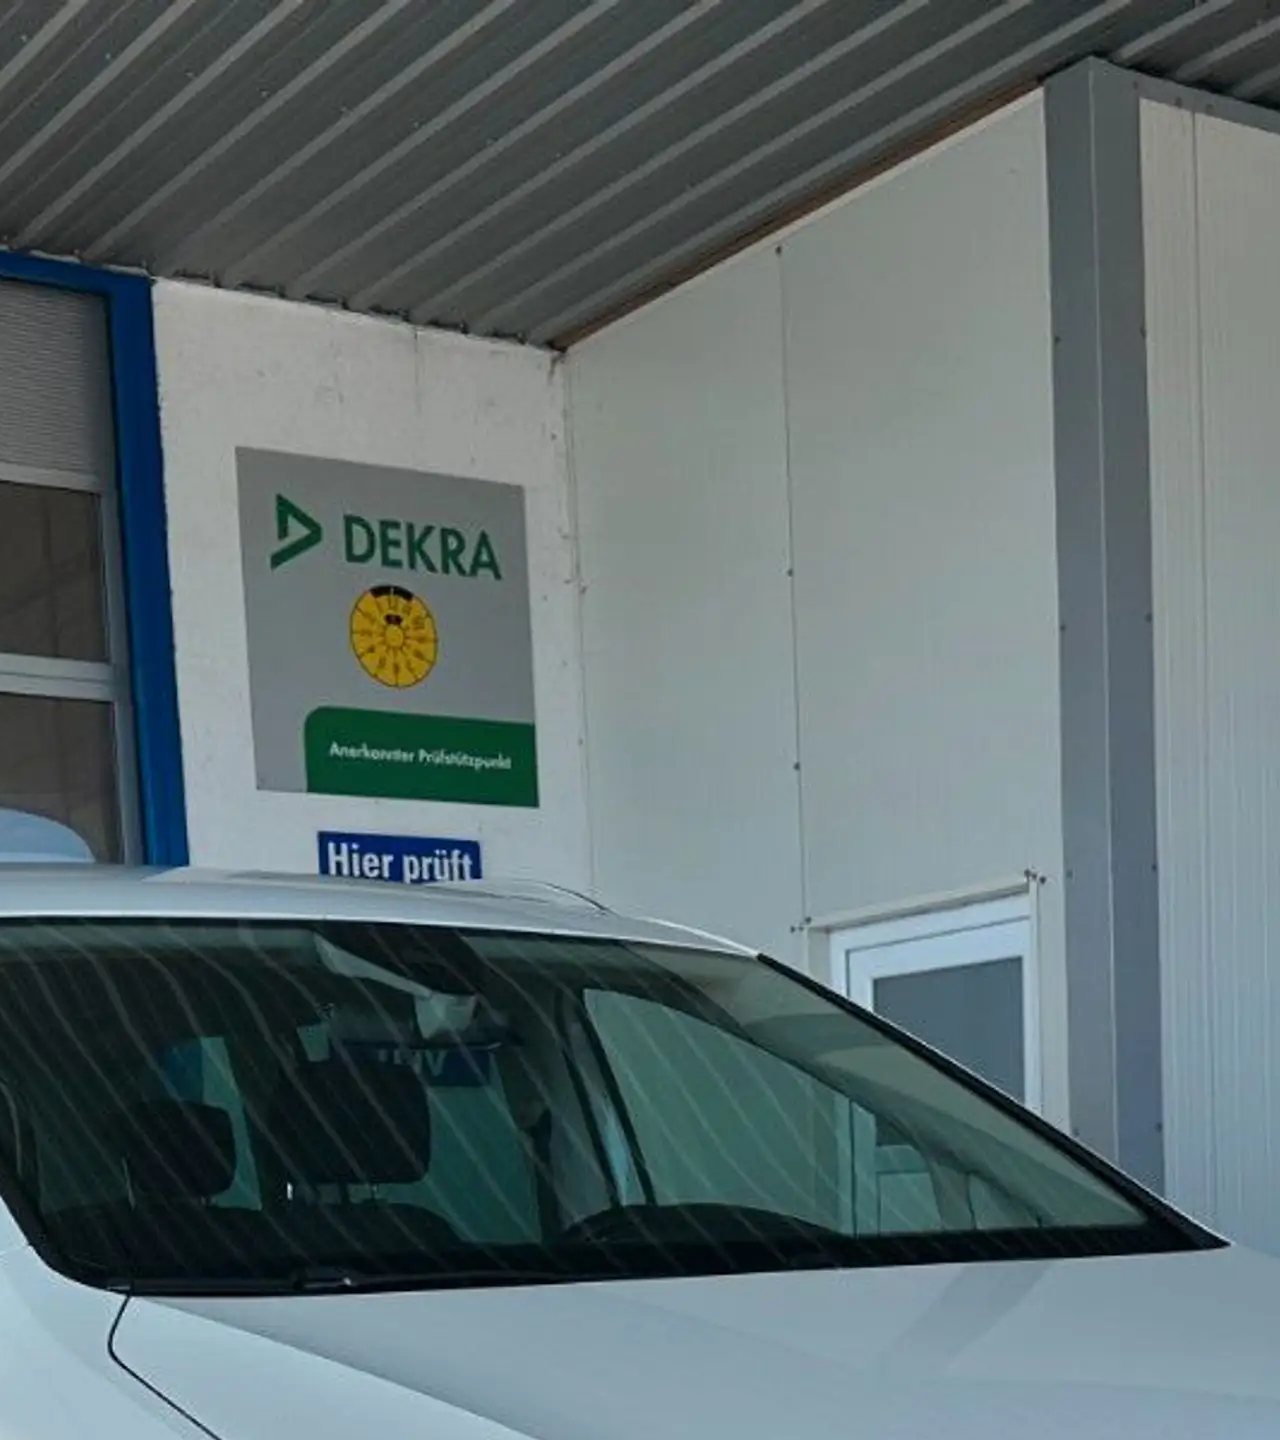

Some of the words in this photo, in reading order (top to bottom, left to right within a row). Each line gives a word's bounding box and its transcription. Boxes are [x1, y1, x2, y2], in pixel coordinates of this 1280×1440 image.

[343, 513, 502, 580] DEKRA
[329, 741, 415, 763] Anerkannter
[418, 748, 512, 771] Prüfstützpunkt
[327, 841, 393, 879] Hier
[402, 849, 472, 883] prüft
